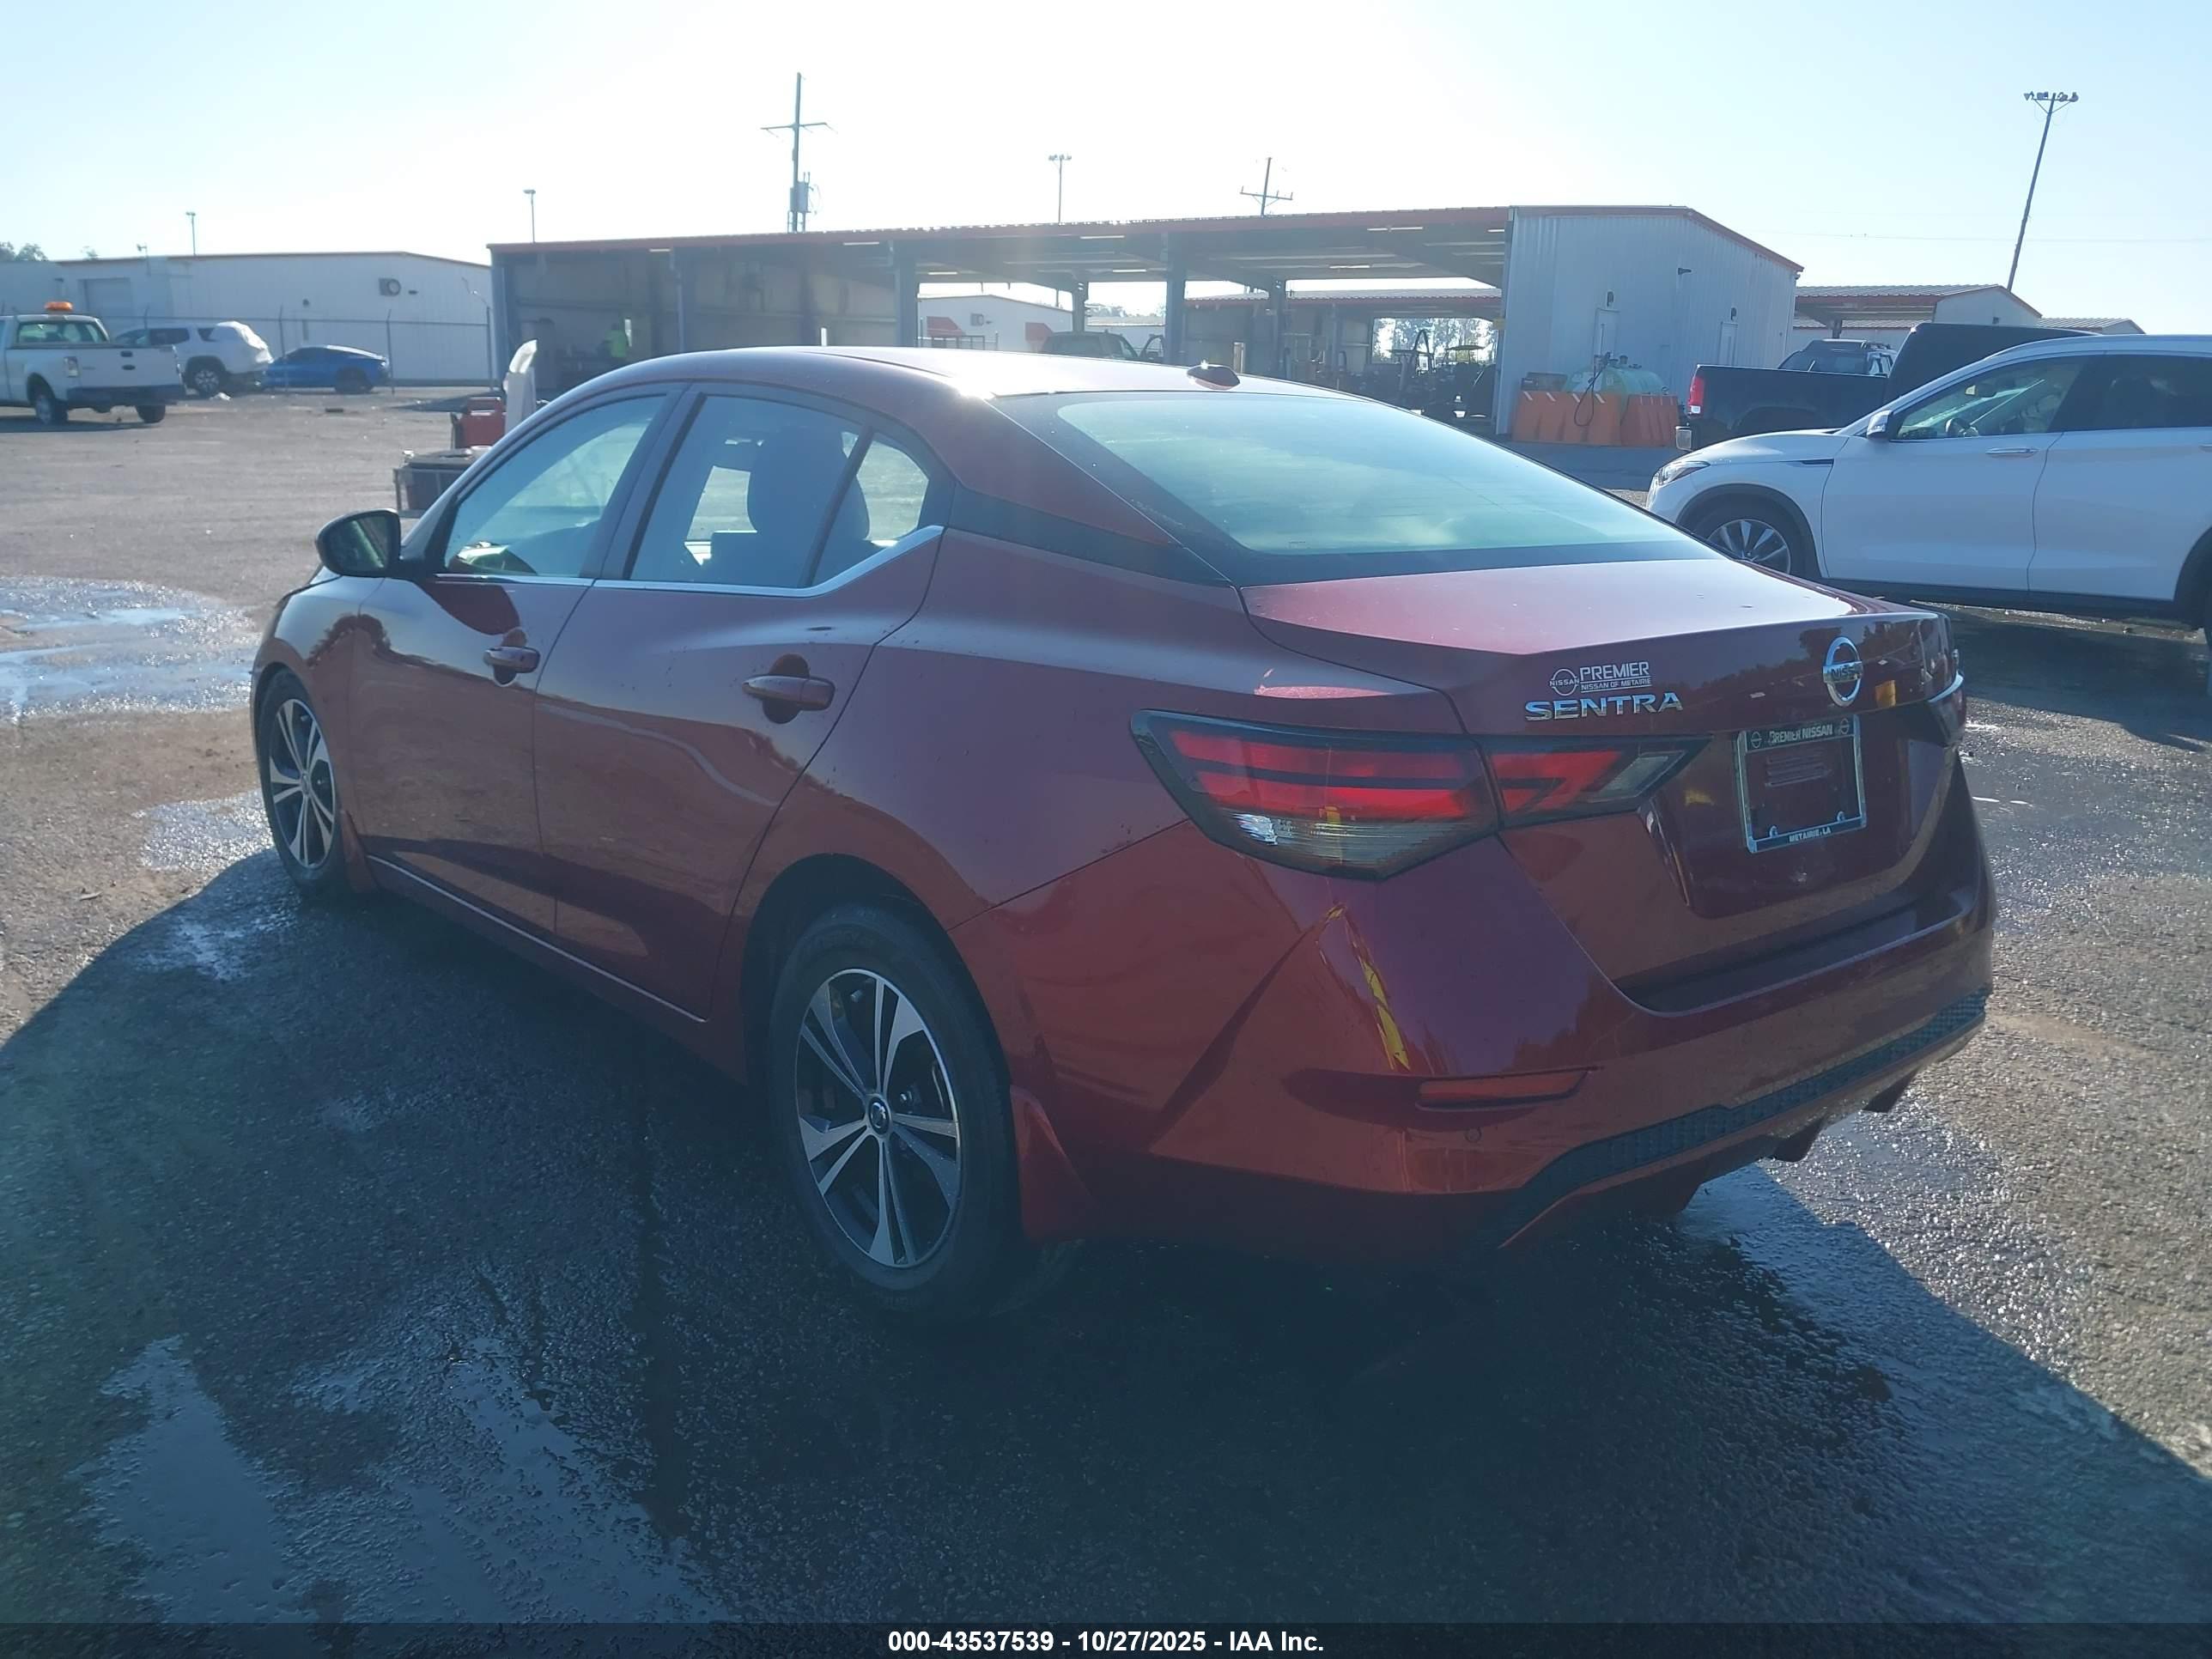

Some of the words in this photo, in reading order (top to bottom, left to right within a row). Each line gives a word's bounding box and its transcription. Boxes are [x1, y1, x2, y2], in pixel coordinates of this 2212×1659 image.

[1580, 662, 1650, 681] PREMIER
[1831, 663, 1862, 681] NISS
[1550, 677, 1579, 687] NISSAN
[1581, 681, 1609, 691] NISSAN
[1620, 678, 1651, 687] METAIRIE
[1524, 692, 1684, 721] SENTRA
[1802, 724, 1833, 739] NISSAN
[1822, 826, 1832, 836] LA
